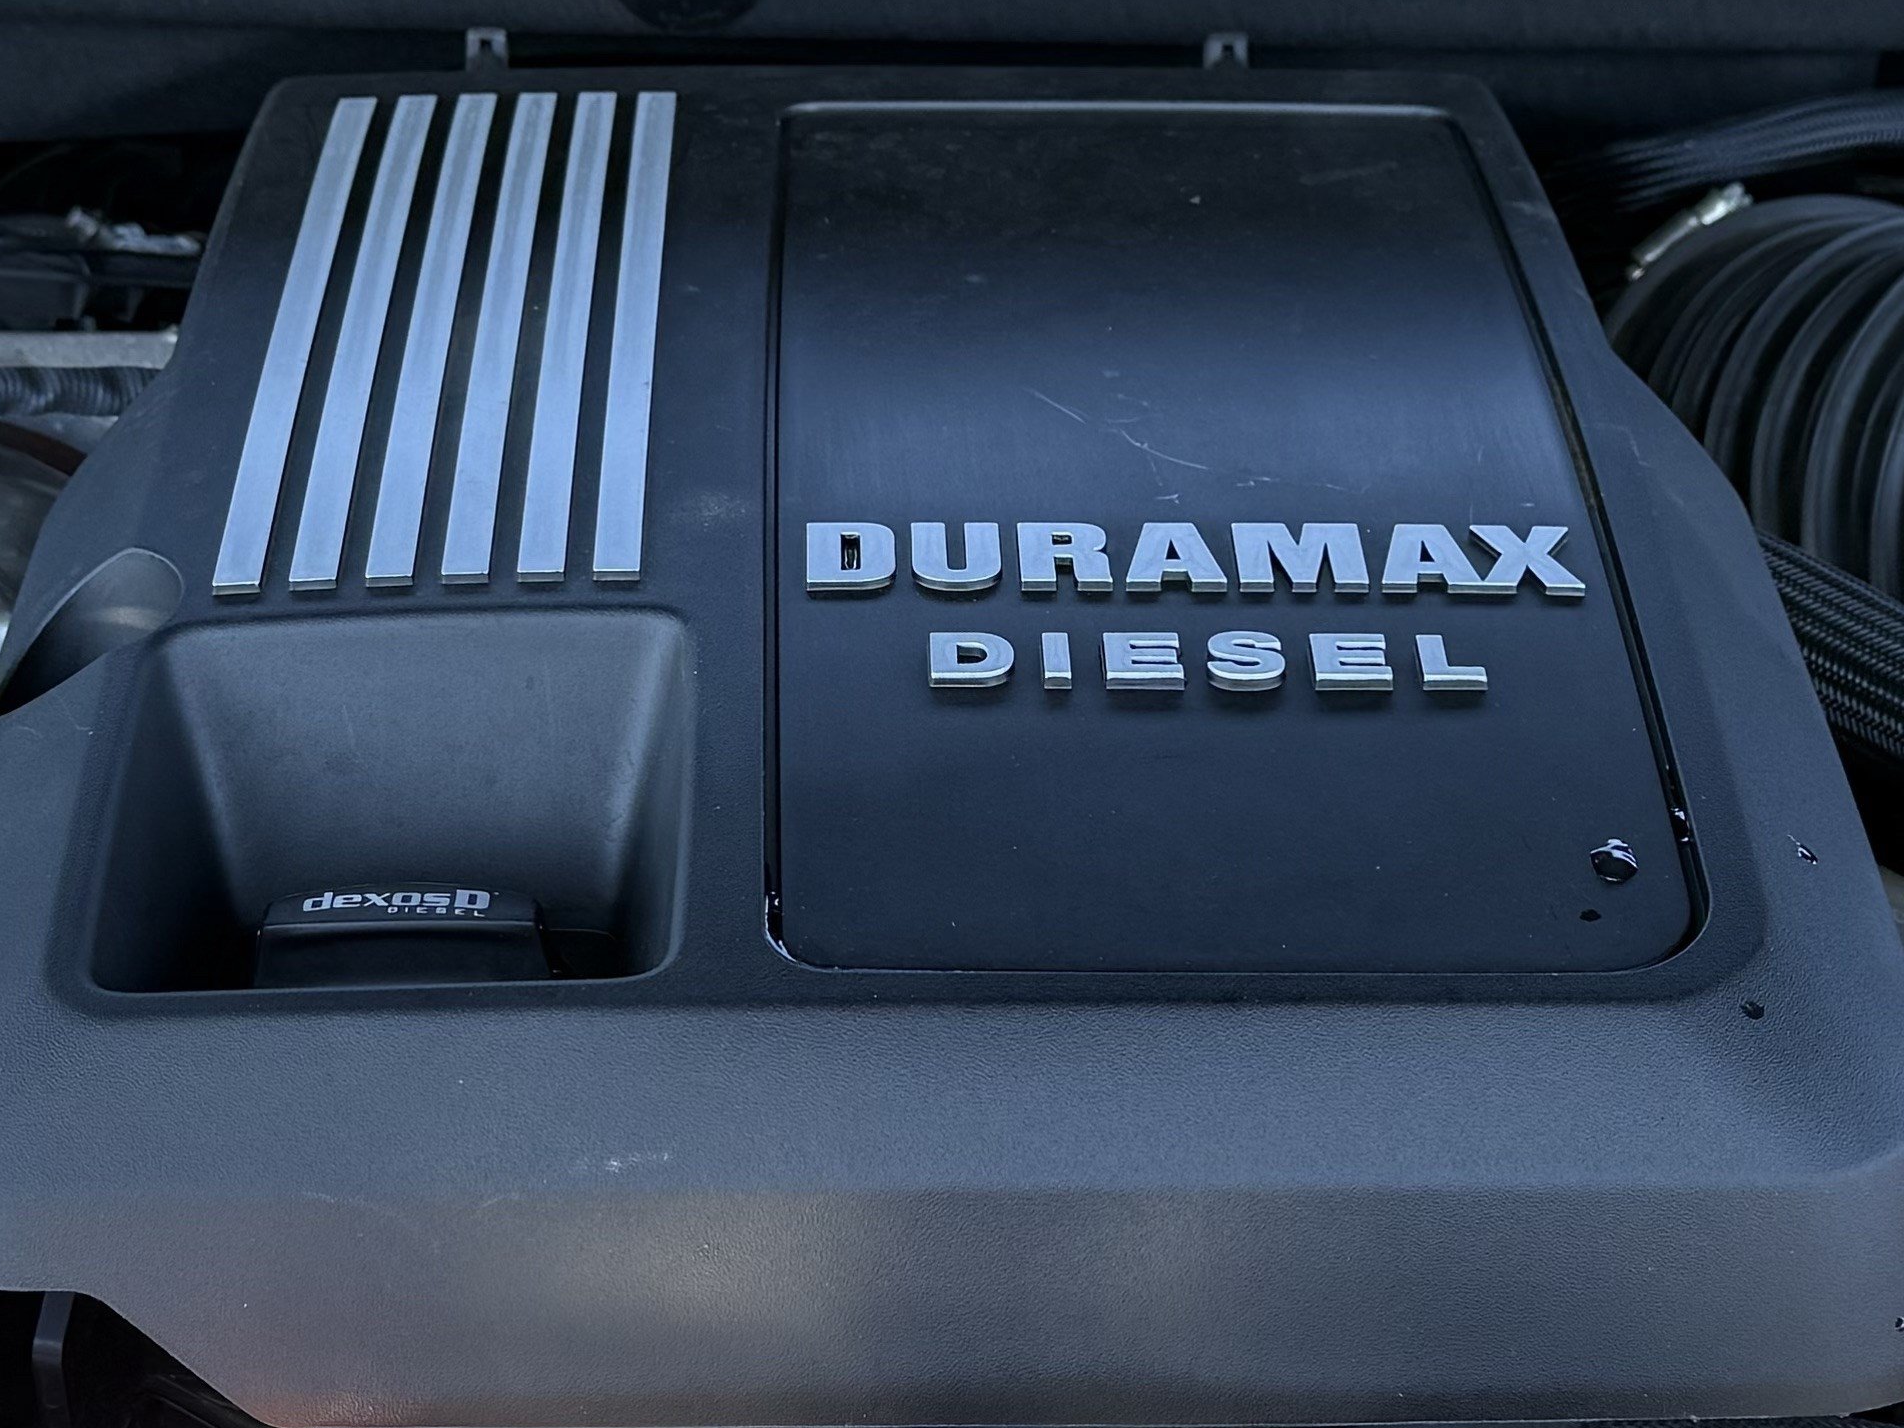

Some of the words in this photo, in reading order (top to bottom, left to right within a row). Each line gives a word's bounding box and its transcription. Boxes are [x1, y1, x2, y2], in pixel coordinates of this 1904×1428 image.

[805, 521, 1586, 597] DURAMAX
[928, 631, 1488, 691] DIESEL
[387, 907, 485, 918] DIESEL
